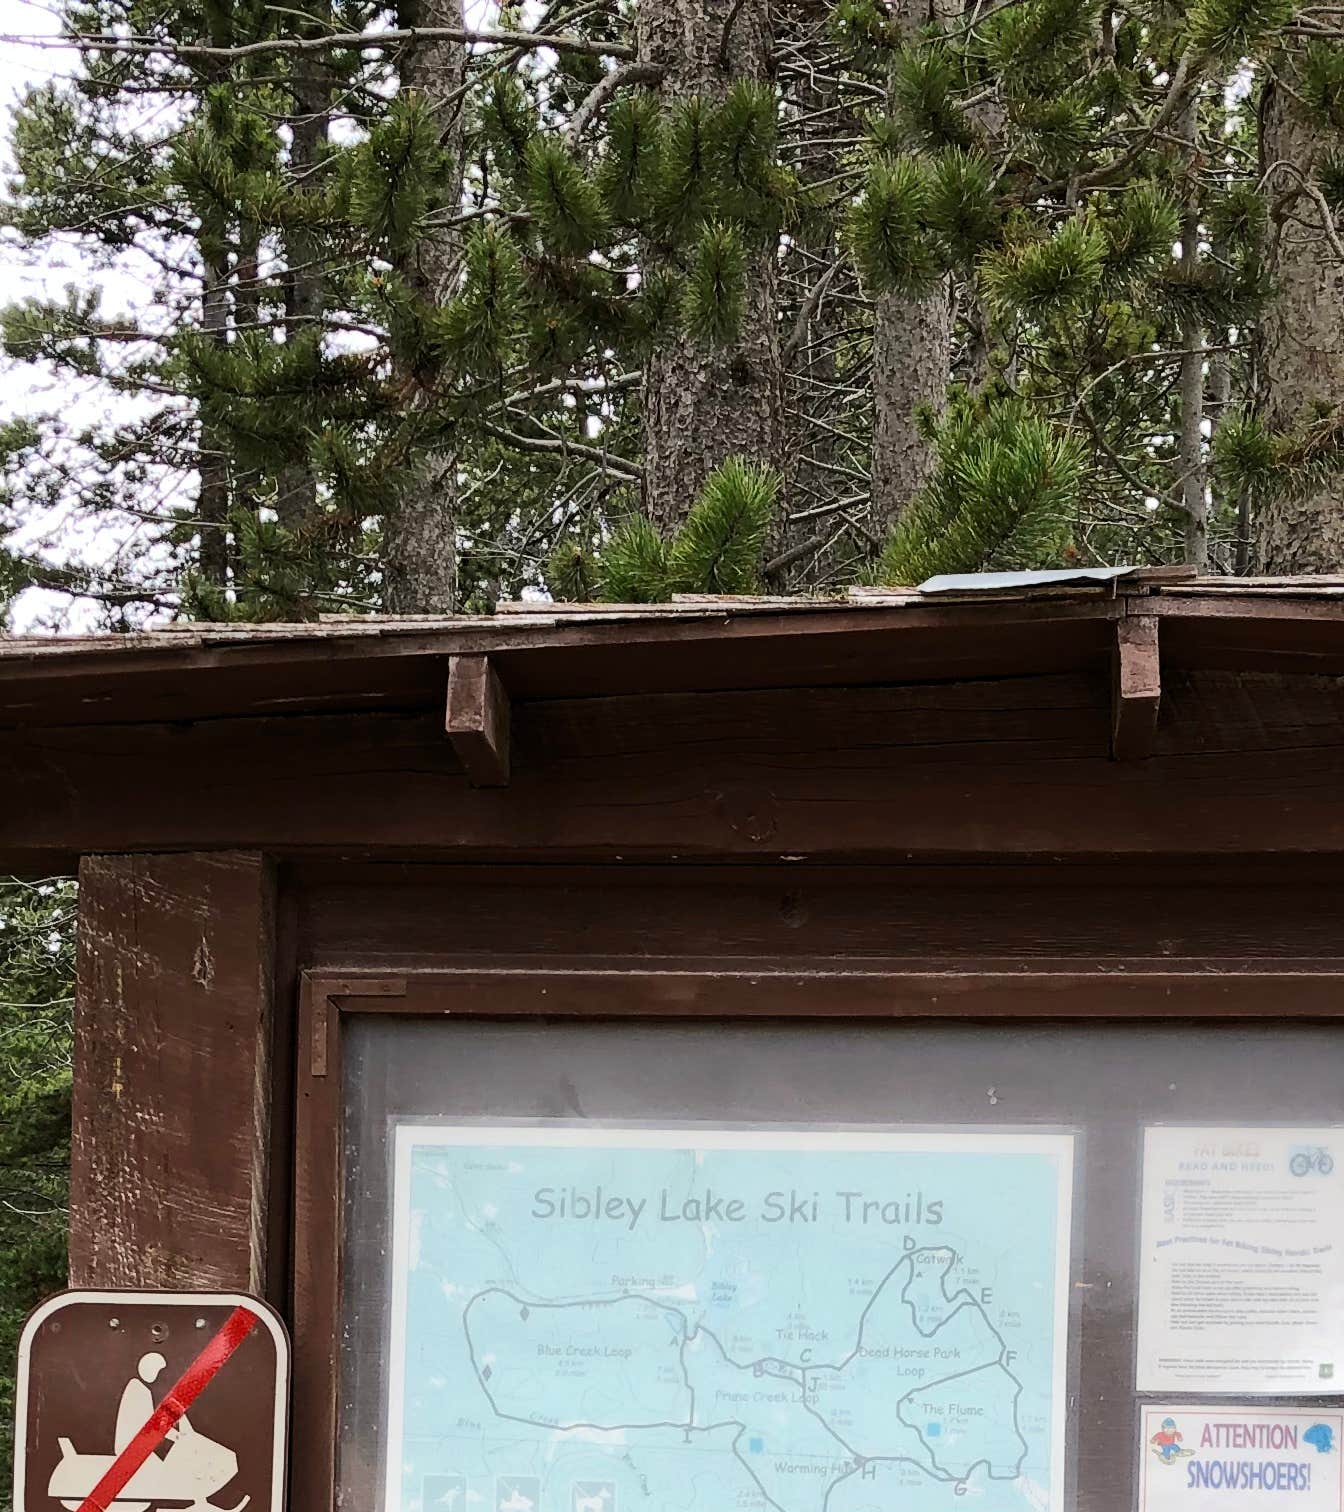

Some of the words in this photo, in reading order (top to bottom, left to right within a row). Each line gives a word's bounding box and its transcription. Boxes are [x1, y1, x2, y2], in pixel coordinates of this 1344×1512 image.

[531, 1185, 647, 1231] Sibley
[660, 1187, 745, 1222] Lake
[761, 1189, 819, 1223] Ski
[836, 1191, 944, 1225] Trails
[903, 1235, 916, 1251] D
[611, 1274, 656, 1288] Parking
[981, 1287, 993, 1304] E
[669, 1335, 679, 1347] A
[537, 1344, 562, 1356] Blue
[565, 1344, 601, 1357] Creek
[605, 1346, 633, 1360] Loop
[800, 1348, 812, 1363] C
[859, 1347, 890, 1359] Dead
[894, 1347, 930, 1359] Horse
[934, 1347, 961, 1359] Park
[1006, 1350, 1018, 1367] F
[897, 1366, 925, 1379] Loop
[716, 1390, 751, 1401] Prune
[753, 1390, 787, 1401] Creek
[923, 1403, 944, 1415] The
[948, 1403, 984, 1416] Flume
[1200, 1423, 1298, 1450] ATTENTION
[775, 1462, 827, 1476] Warming
[862, 1464, 876, 1480] H
[1187, 1460, 1312, 1491] SNOWSHOERS!
